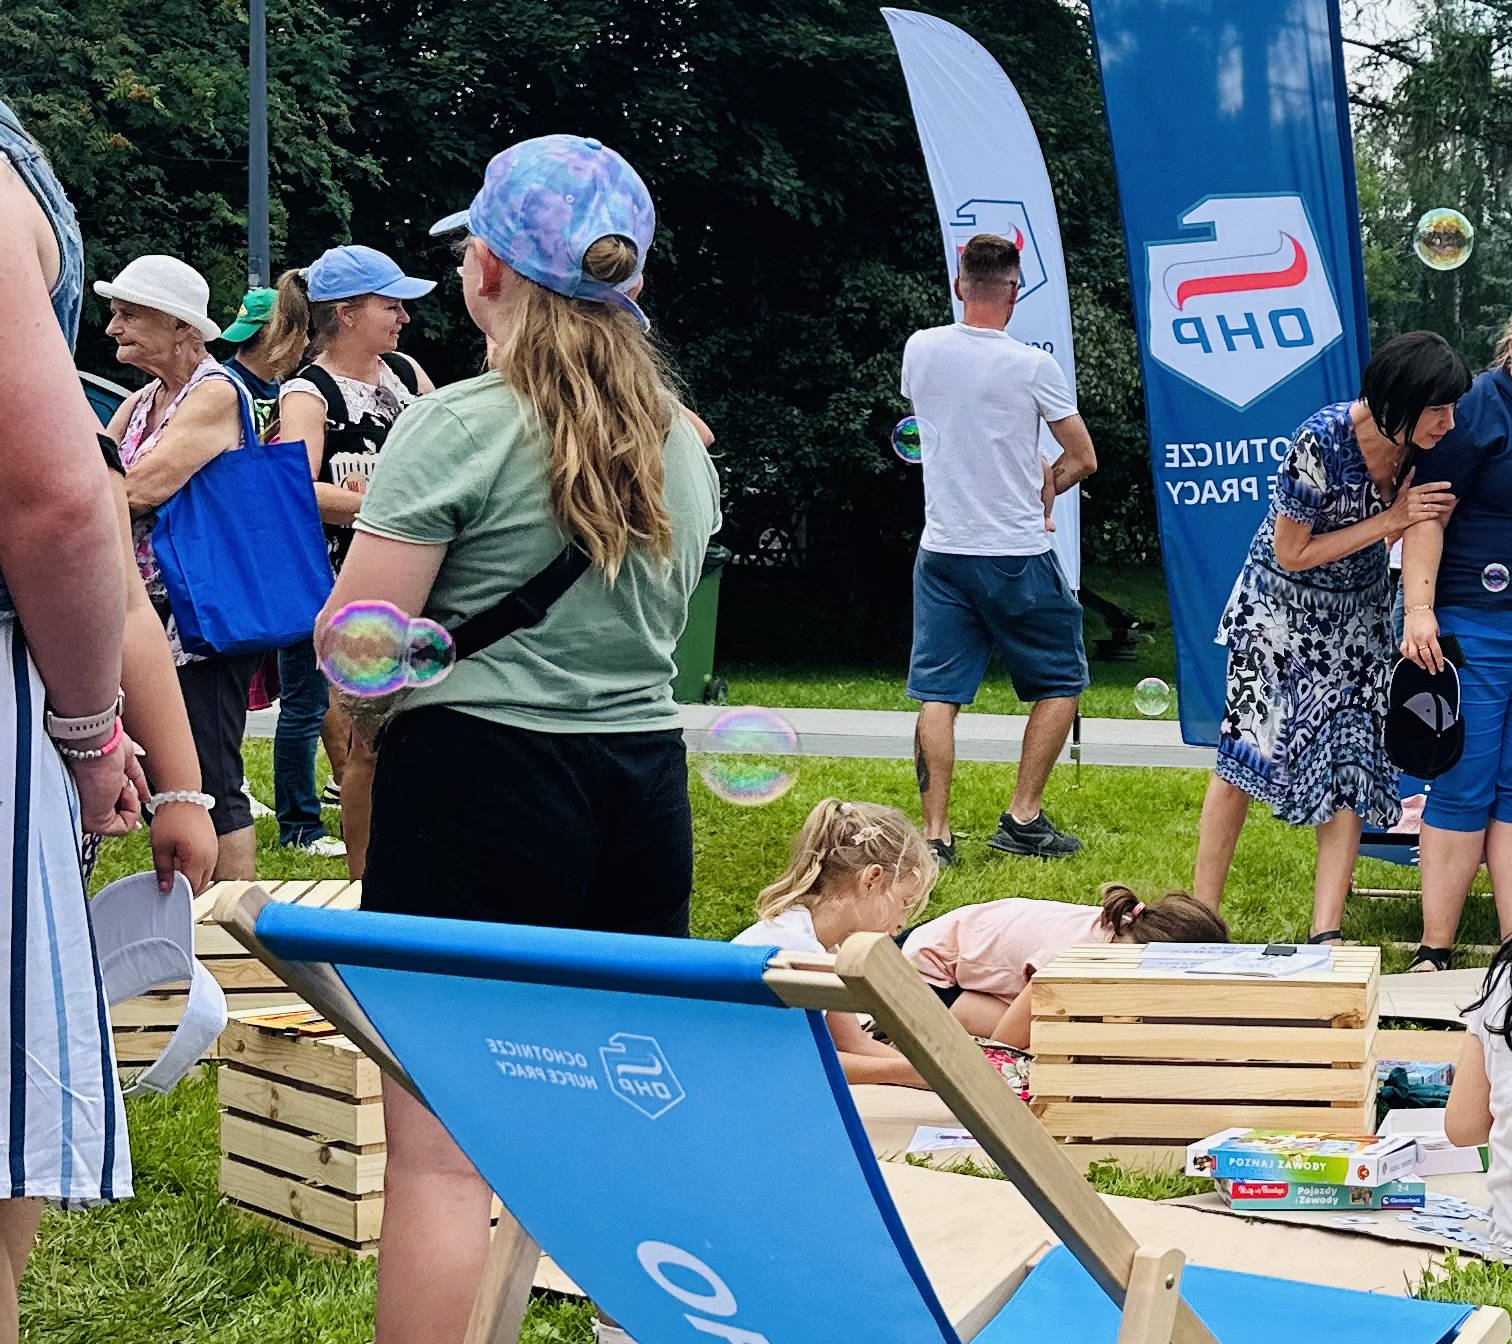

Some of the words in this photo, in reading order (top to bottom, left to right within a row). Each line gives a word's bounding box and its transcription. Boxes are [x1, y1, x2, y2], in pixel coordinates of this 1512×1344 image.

[1228, 1157, 1274, 1169] POZNAJ
[1277, 1159, 1327, 1171] ZAWODY
[1297, 1186, 1338, 1197] Pojazdy
[1299, 1196, 1339, 1206] Zawody
